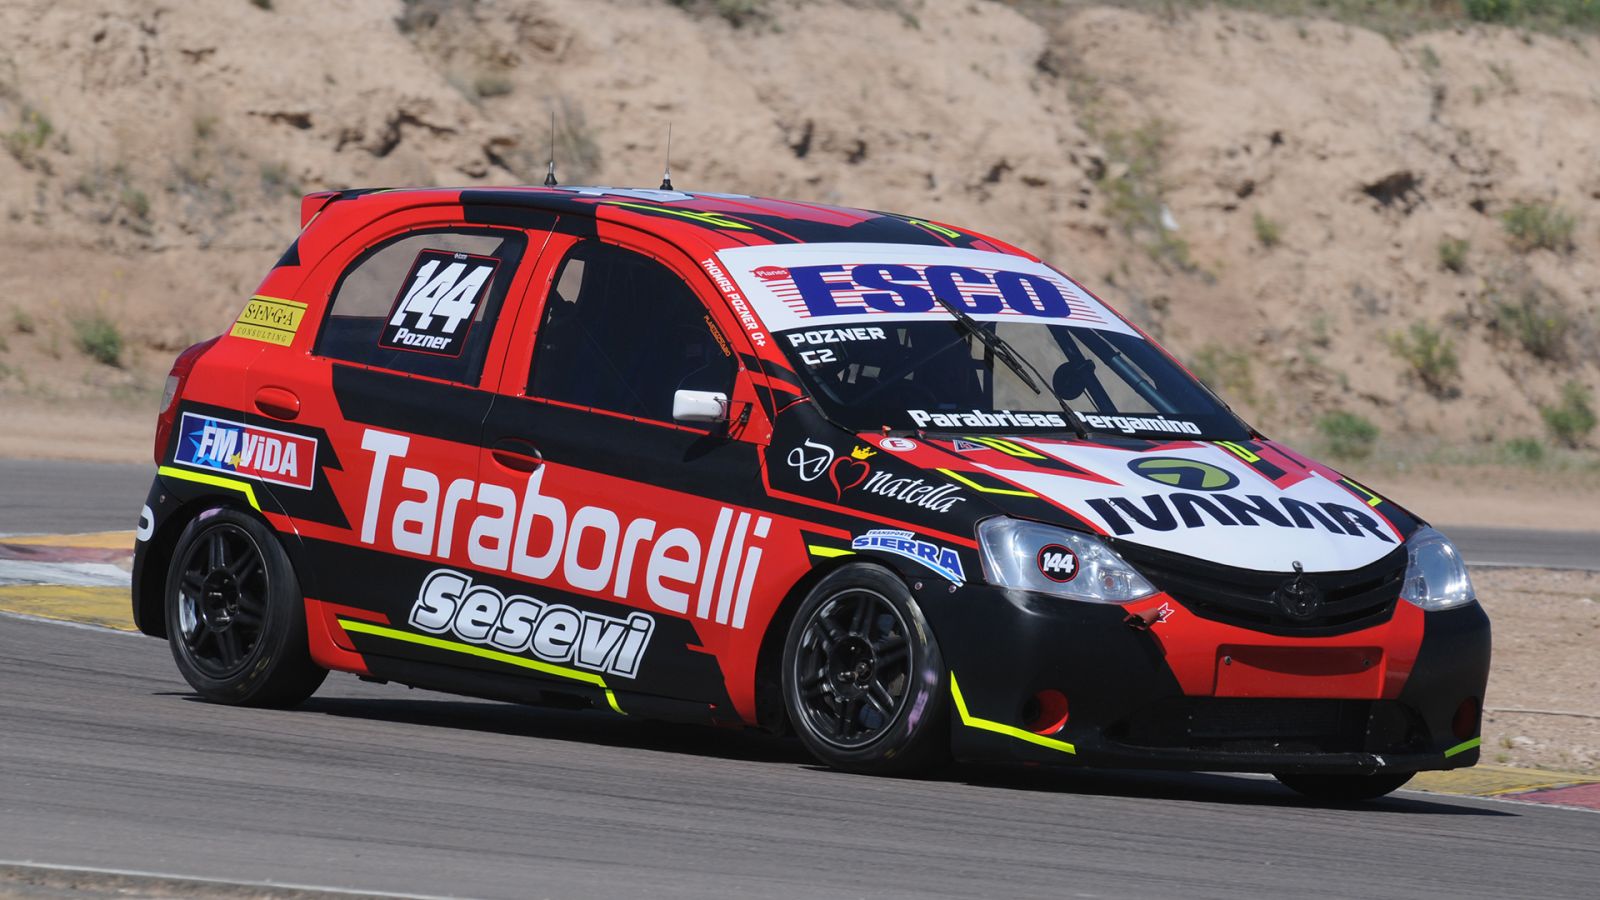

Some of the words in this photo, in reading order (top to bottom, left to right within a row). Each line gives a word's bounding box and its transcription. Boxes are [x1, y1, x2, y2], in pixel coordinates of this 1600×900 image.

[388, 259, 494, 334] 144
[702, 258, 736, 292] THOMAS
[727, 293, 759, 331] POZNER
[788, 264, 1071, 317] ESCO
[236, 327, 287, 342] CONSULTING
[392, 328, 453, 350] Pozner
[786, 326, 887, 347] POZNER
[800, 348, 837, 366] C2
[907, 409, 1067, 428] Parabrisas
[197, 425, 239, 463] FM
[360, 428, 772, 630] Taraborelli
[868, 530, 912, 538] TRANSPORTE
[1084, 492, 1397, 544] IVANAR
[853, 537, 965, 578] SIERRA
[1043, 552, 1075, 574] 144
[408, 568, 656, 680] Sesevi
